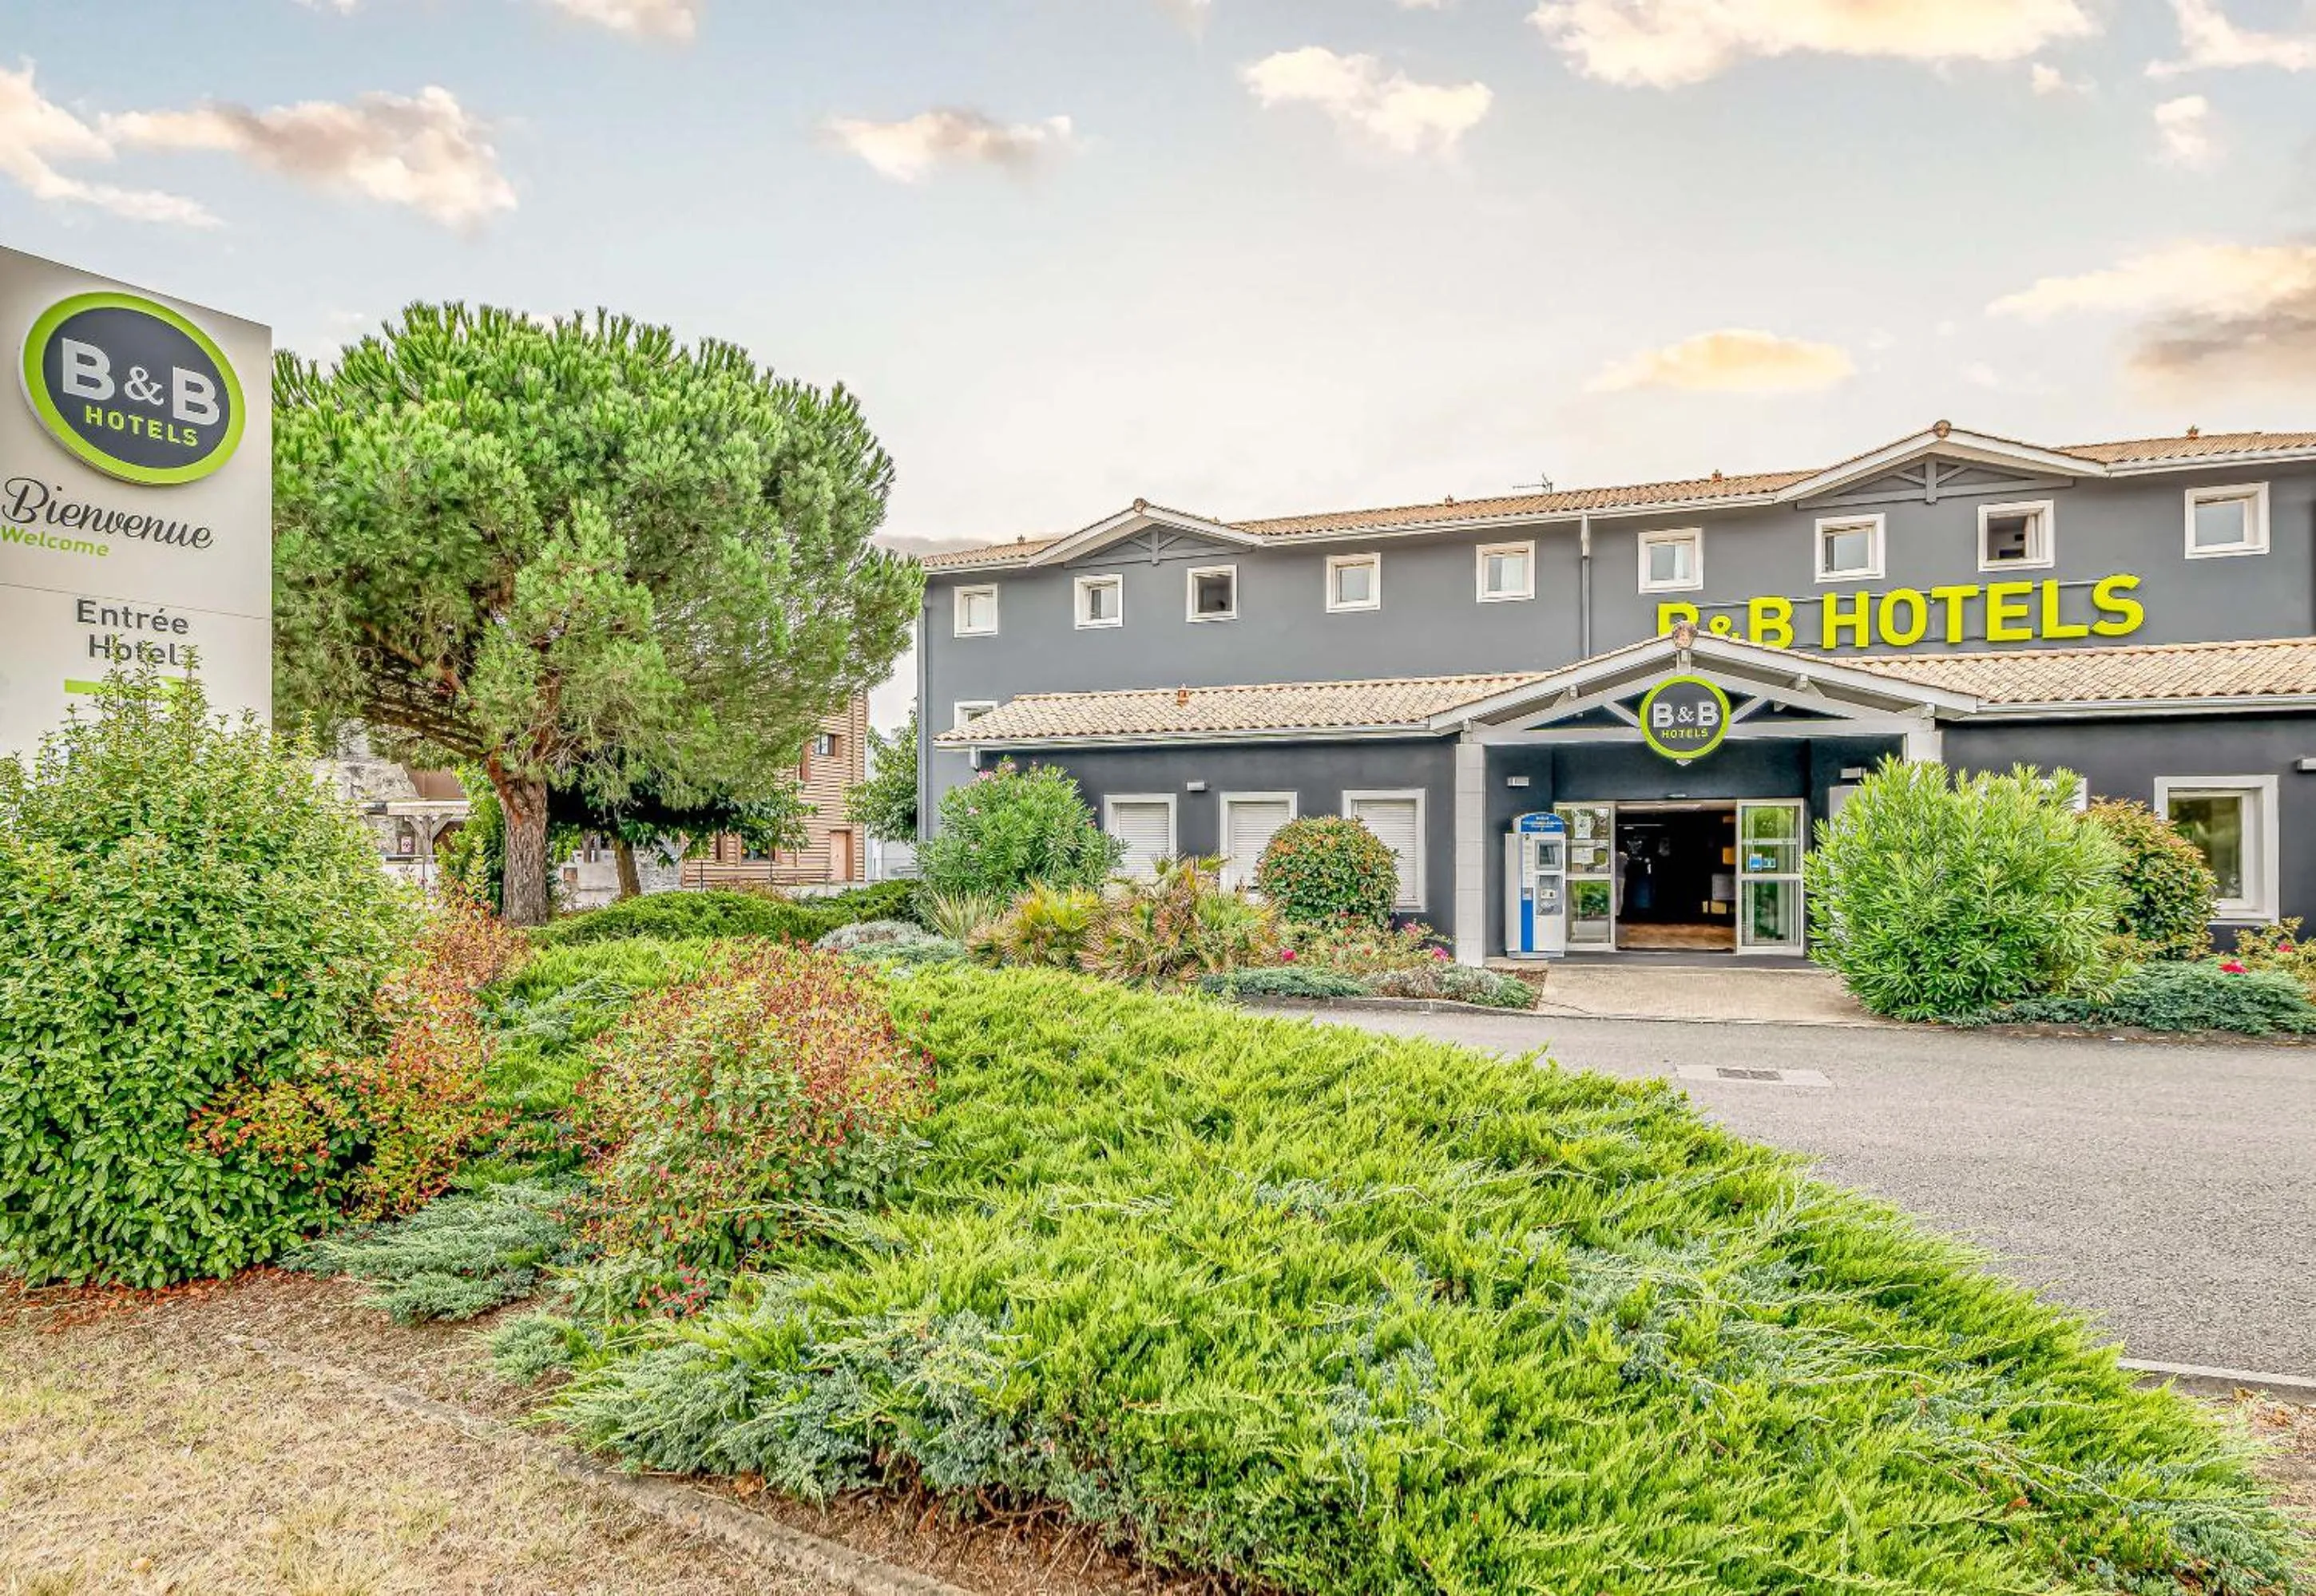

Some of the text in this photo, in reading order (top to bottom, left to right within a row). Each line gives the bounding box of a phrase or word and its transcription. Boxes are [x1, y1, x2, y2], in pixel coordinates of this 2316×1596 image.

[85, 405, 199, 447] HOTELS
[2, 477, 214, 549] Bienvenue
[1, 524, 109, 556] Welcome
[77, 598, 189, 635] Entrée
[1822, 573, 2144, 649] HOTELS
[1661, 728, 1708, 739] HOTELS
